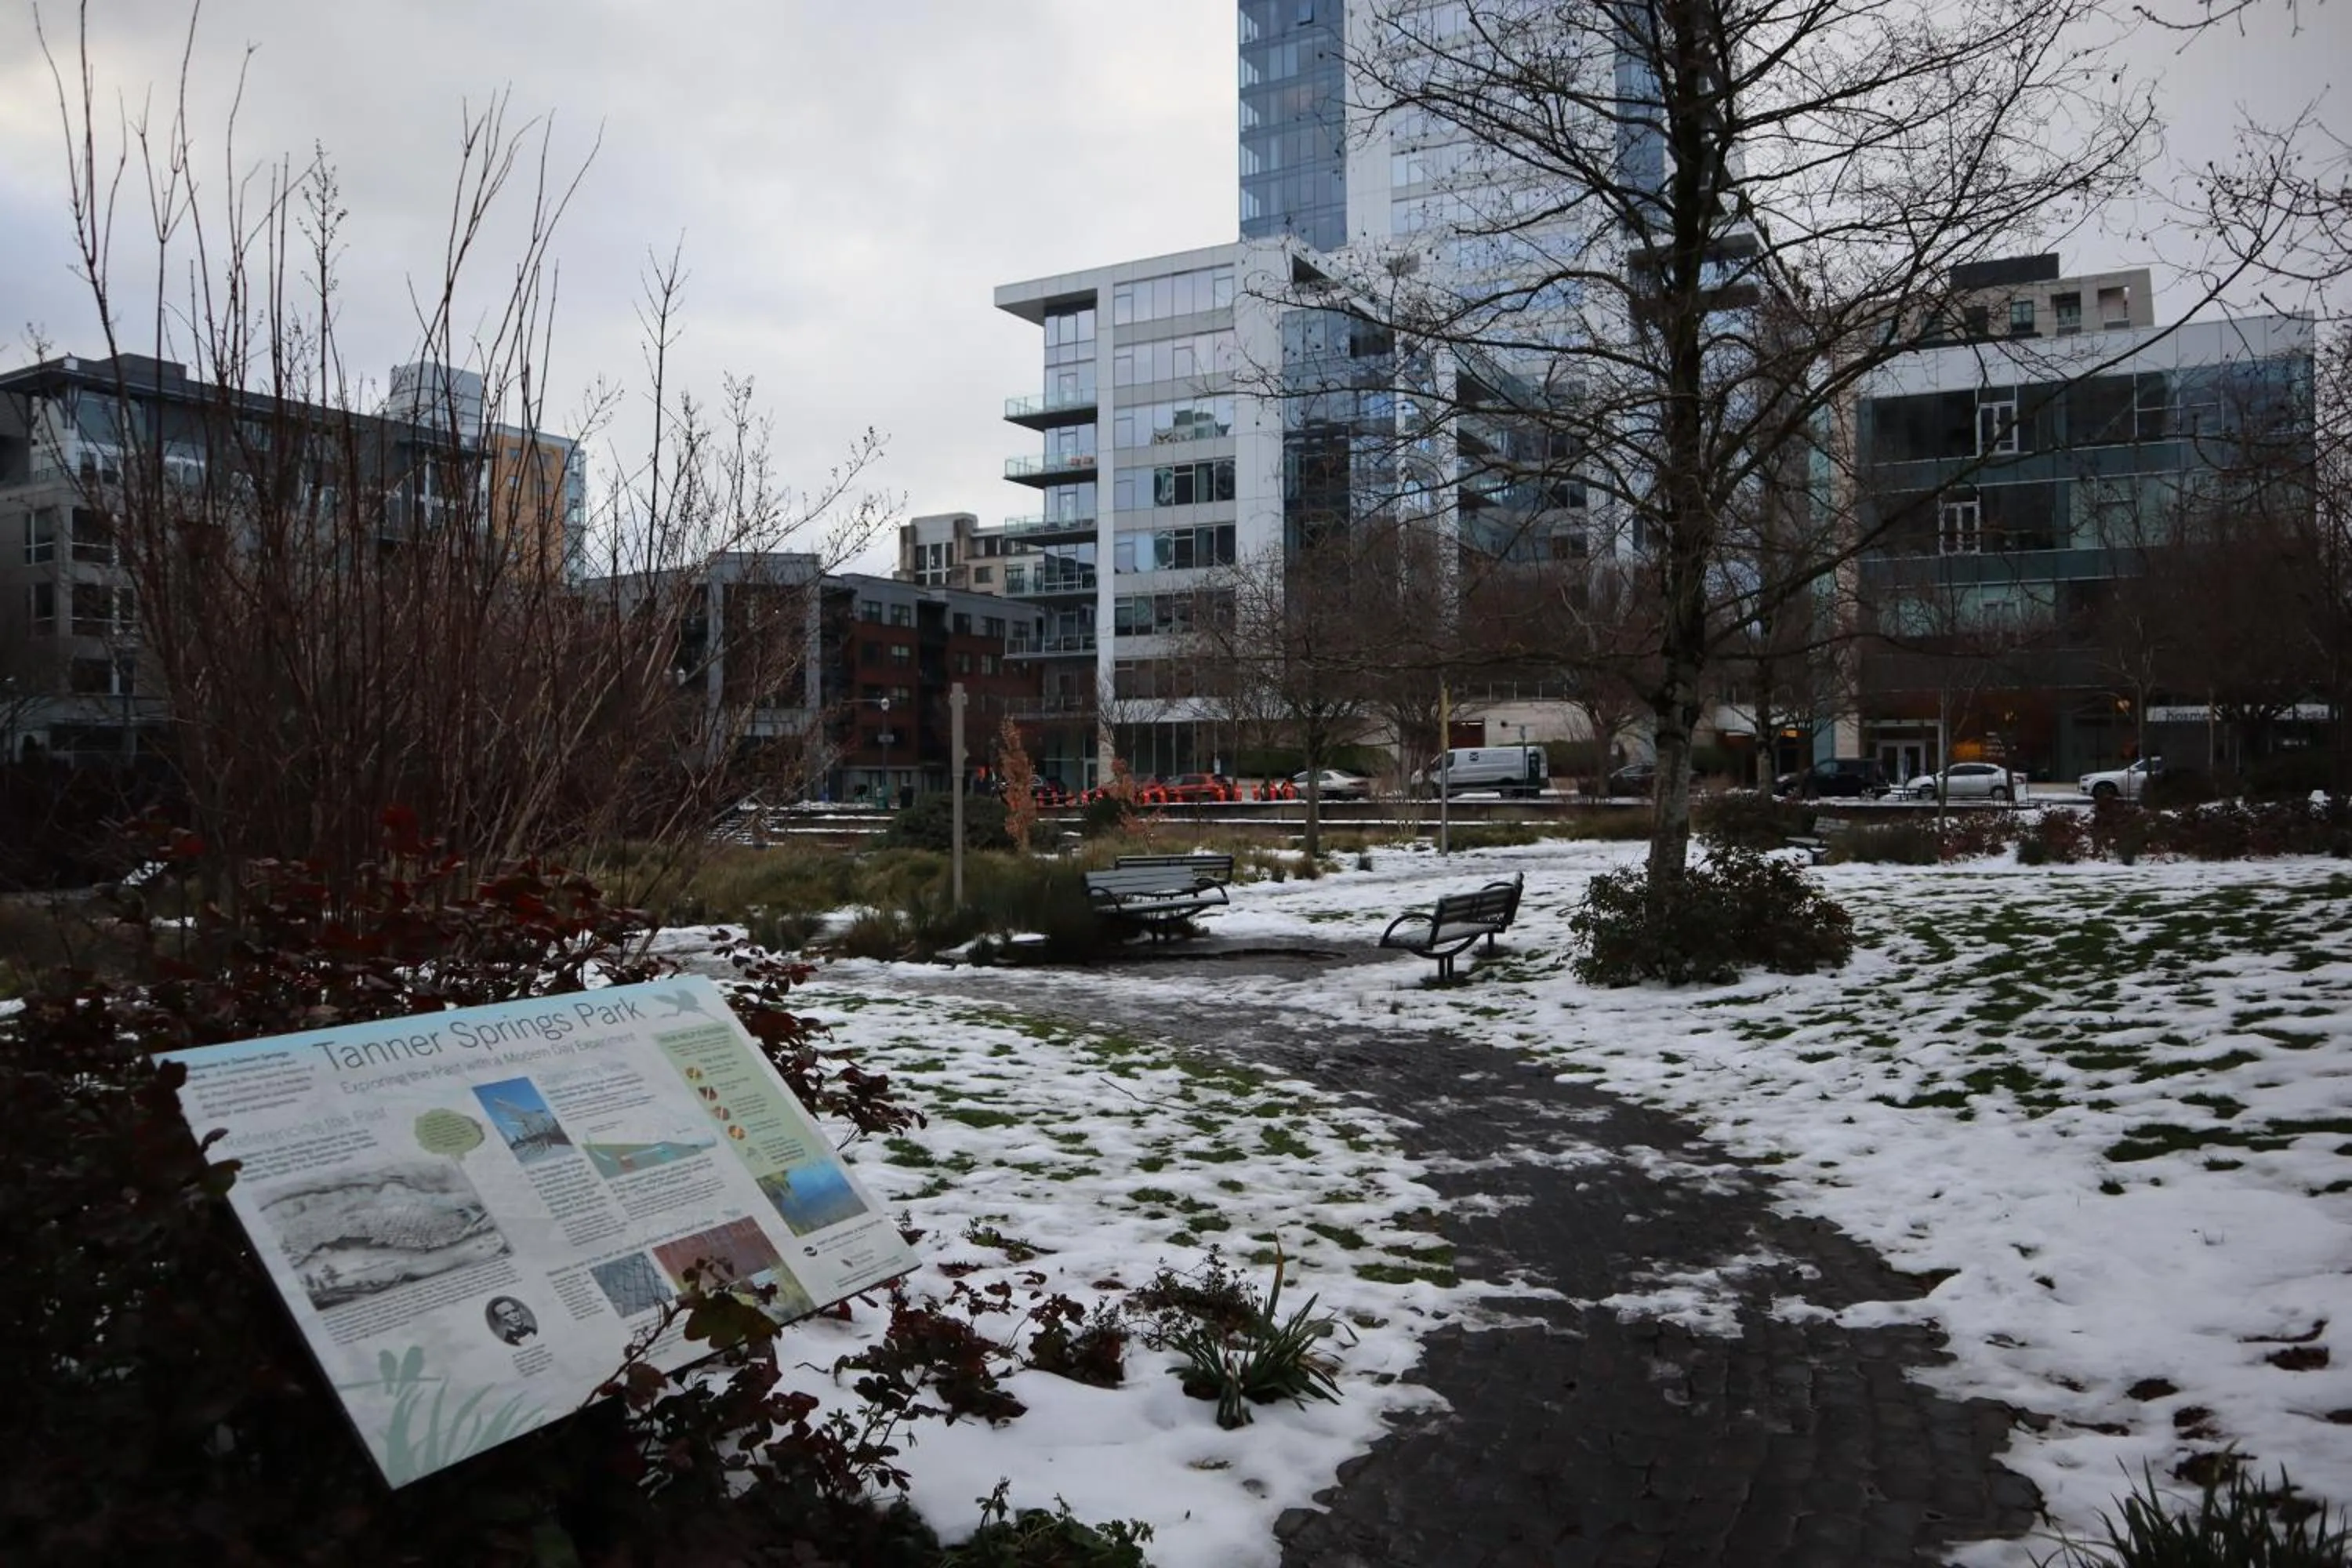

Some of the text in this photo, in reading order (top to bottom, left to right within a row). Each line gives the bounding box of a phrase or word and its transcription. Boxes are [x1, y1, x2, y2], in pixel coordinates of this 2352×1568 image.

[311, 996, 647, 1072] Tanner Springs Park
[339, 1072, 409, 1094] Exploring
[406, 1067, 431, 1083] the
[432, 1062, 461, 1077] Past
[466, 1058, 492, 1072] with
[503, 1047, 550, 1064] Modern
[549, 1043, 575, 1056] Day
[575, 1032, 637, 1051] Experiment
